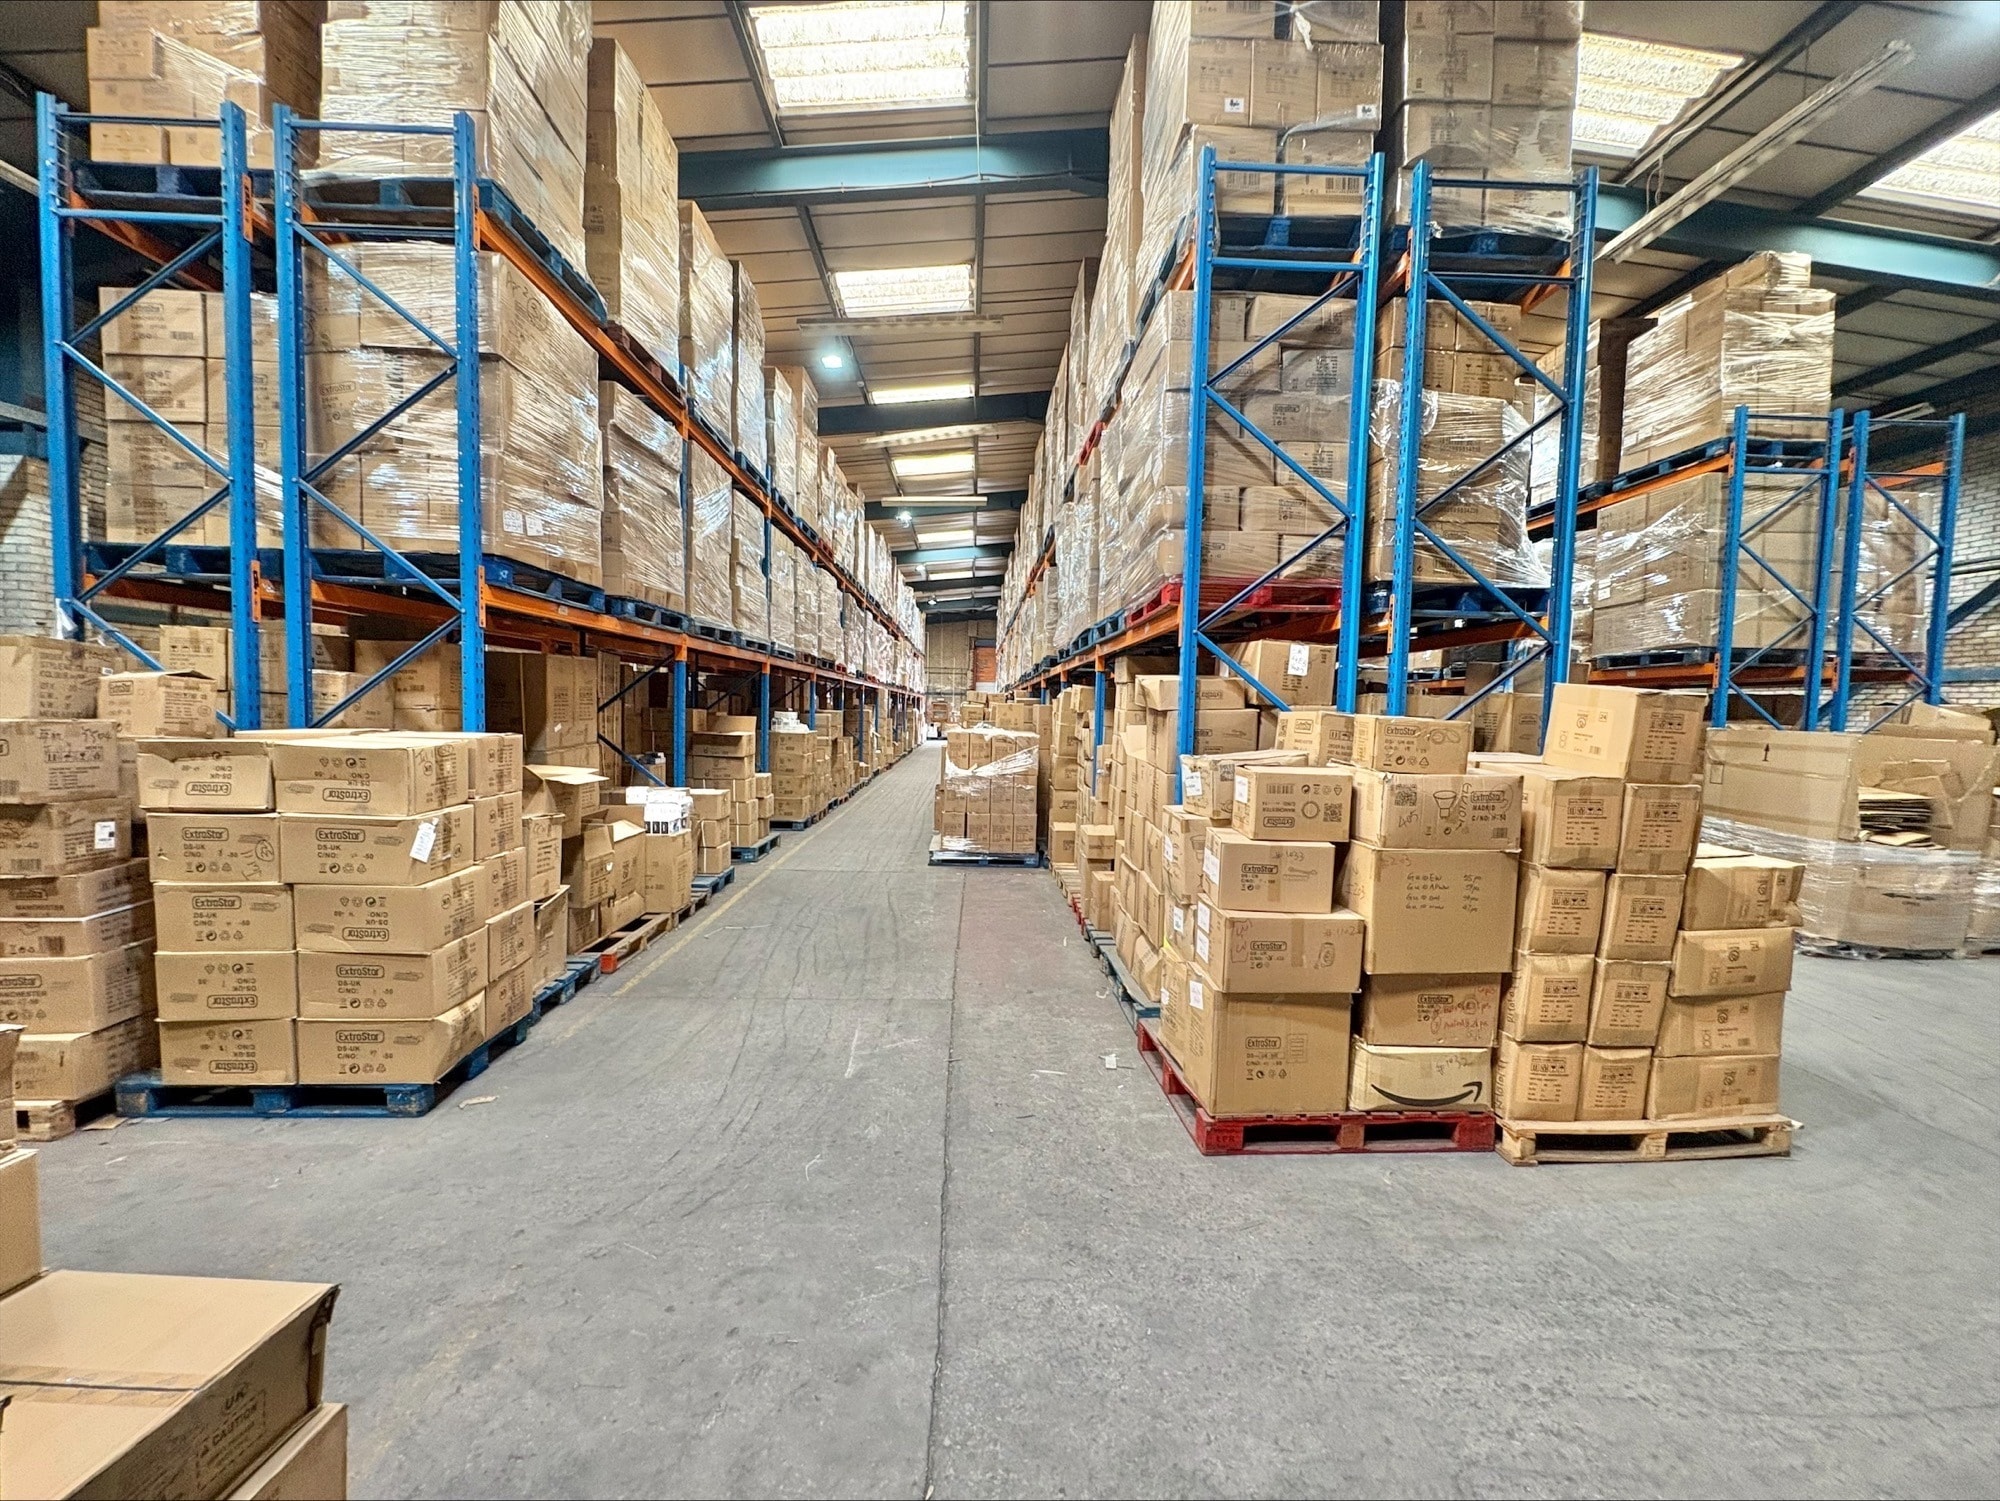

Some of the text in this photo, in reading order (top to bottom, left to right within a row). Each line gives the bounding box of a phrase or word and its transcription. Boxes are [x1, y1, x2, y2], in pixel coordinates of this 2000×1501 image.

[188, 783, 230, 795] ExtraStar
[326, 789, 369, 801] ExtraStar
[182, 829, 226, 840] ExtraStar
[317, 830, 361, 841] ExtraStar
[1242, 865, 1276, 874] ExtraStar
[193, 898, 238, 908] ExtraStar
[346, 928, 388, 940] ExtraStar
[1251, 942, 1285, 951] ExtraStar
[338, 966, 382, 976] ExtraStar
[211, 995, 256, 1006] ExtraStar
[337, 1031, 382, 1042] ExtraStar
[1246, 1038, 1279, 1048] ExtraStar
[213, 1061, 256, 1072] ExtraStar
[225, 1381, 250, 1410] UK
